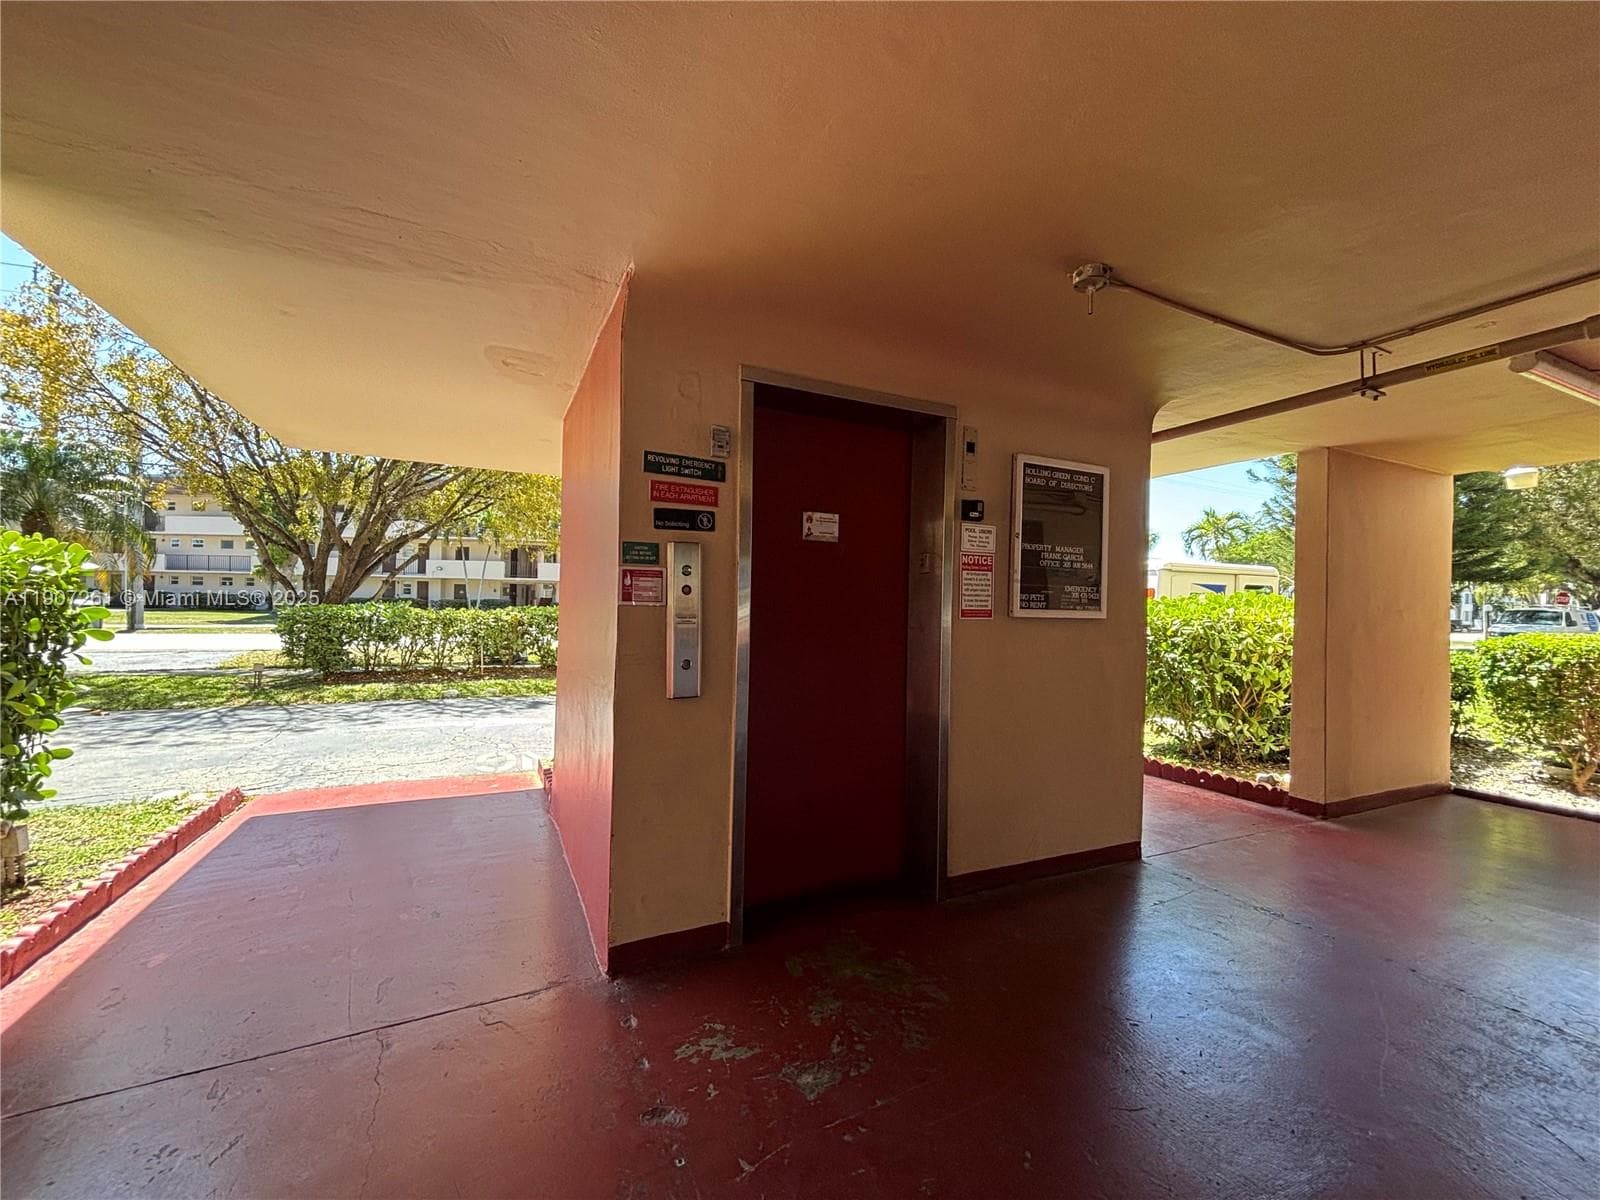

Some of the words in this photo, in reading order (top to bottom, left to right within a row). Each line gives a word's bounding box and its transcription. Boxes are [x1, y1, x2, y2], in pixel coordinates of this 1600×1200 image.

[647, 454, 680, 465] REVOLVING
[682, 458, 715, 470] EMERGENCY
[661, 465, 679, 473] LIGHT
[680, 467, 702, 477] SWITCH
[655, 483, 669, 491] FIRE
[671, 485, 714, 496] EXTINGUISHER
[1025, 476, 1046, 486] BOARD
[1060, 482, 1093, 492] DIRECTORS
[660, 490, 679, 499] EACH
[680, 493, 716, 503] APARTMENT
[1055, 545, 1084, 554] MANAGER
[962, 555, 993, 565] NOTICE
[1040, 560, 1061, 568] OFFICE
[1029, 593, 1045, 601] PETS
